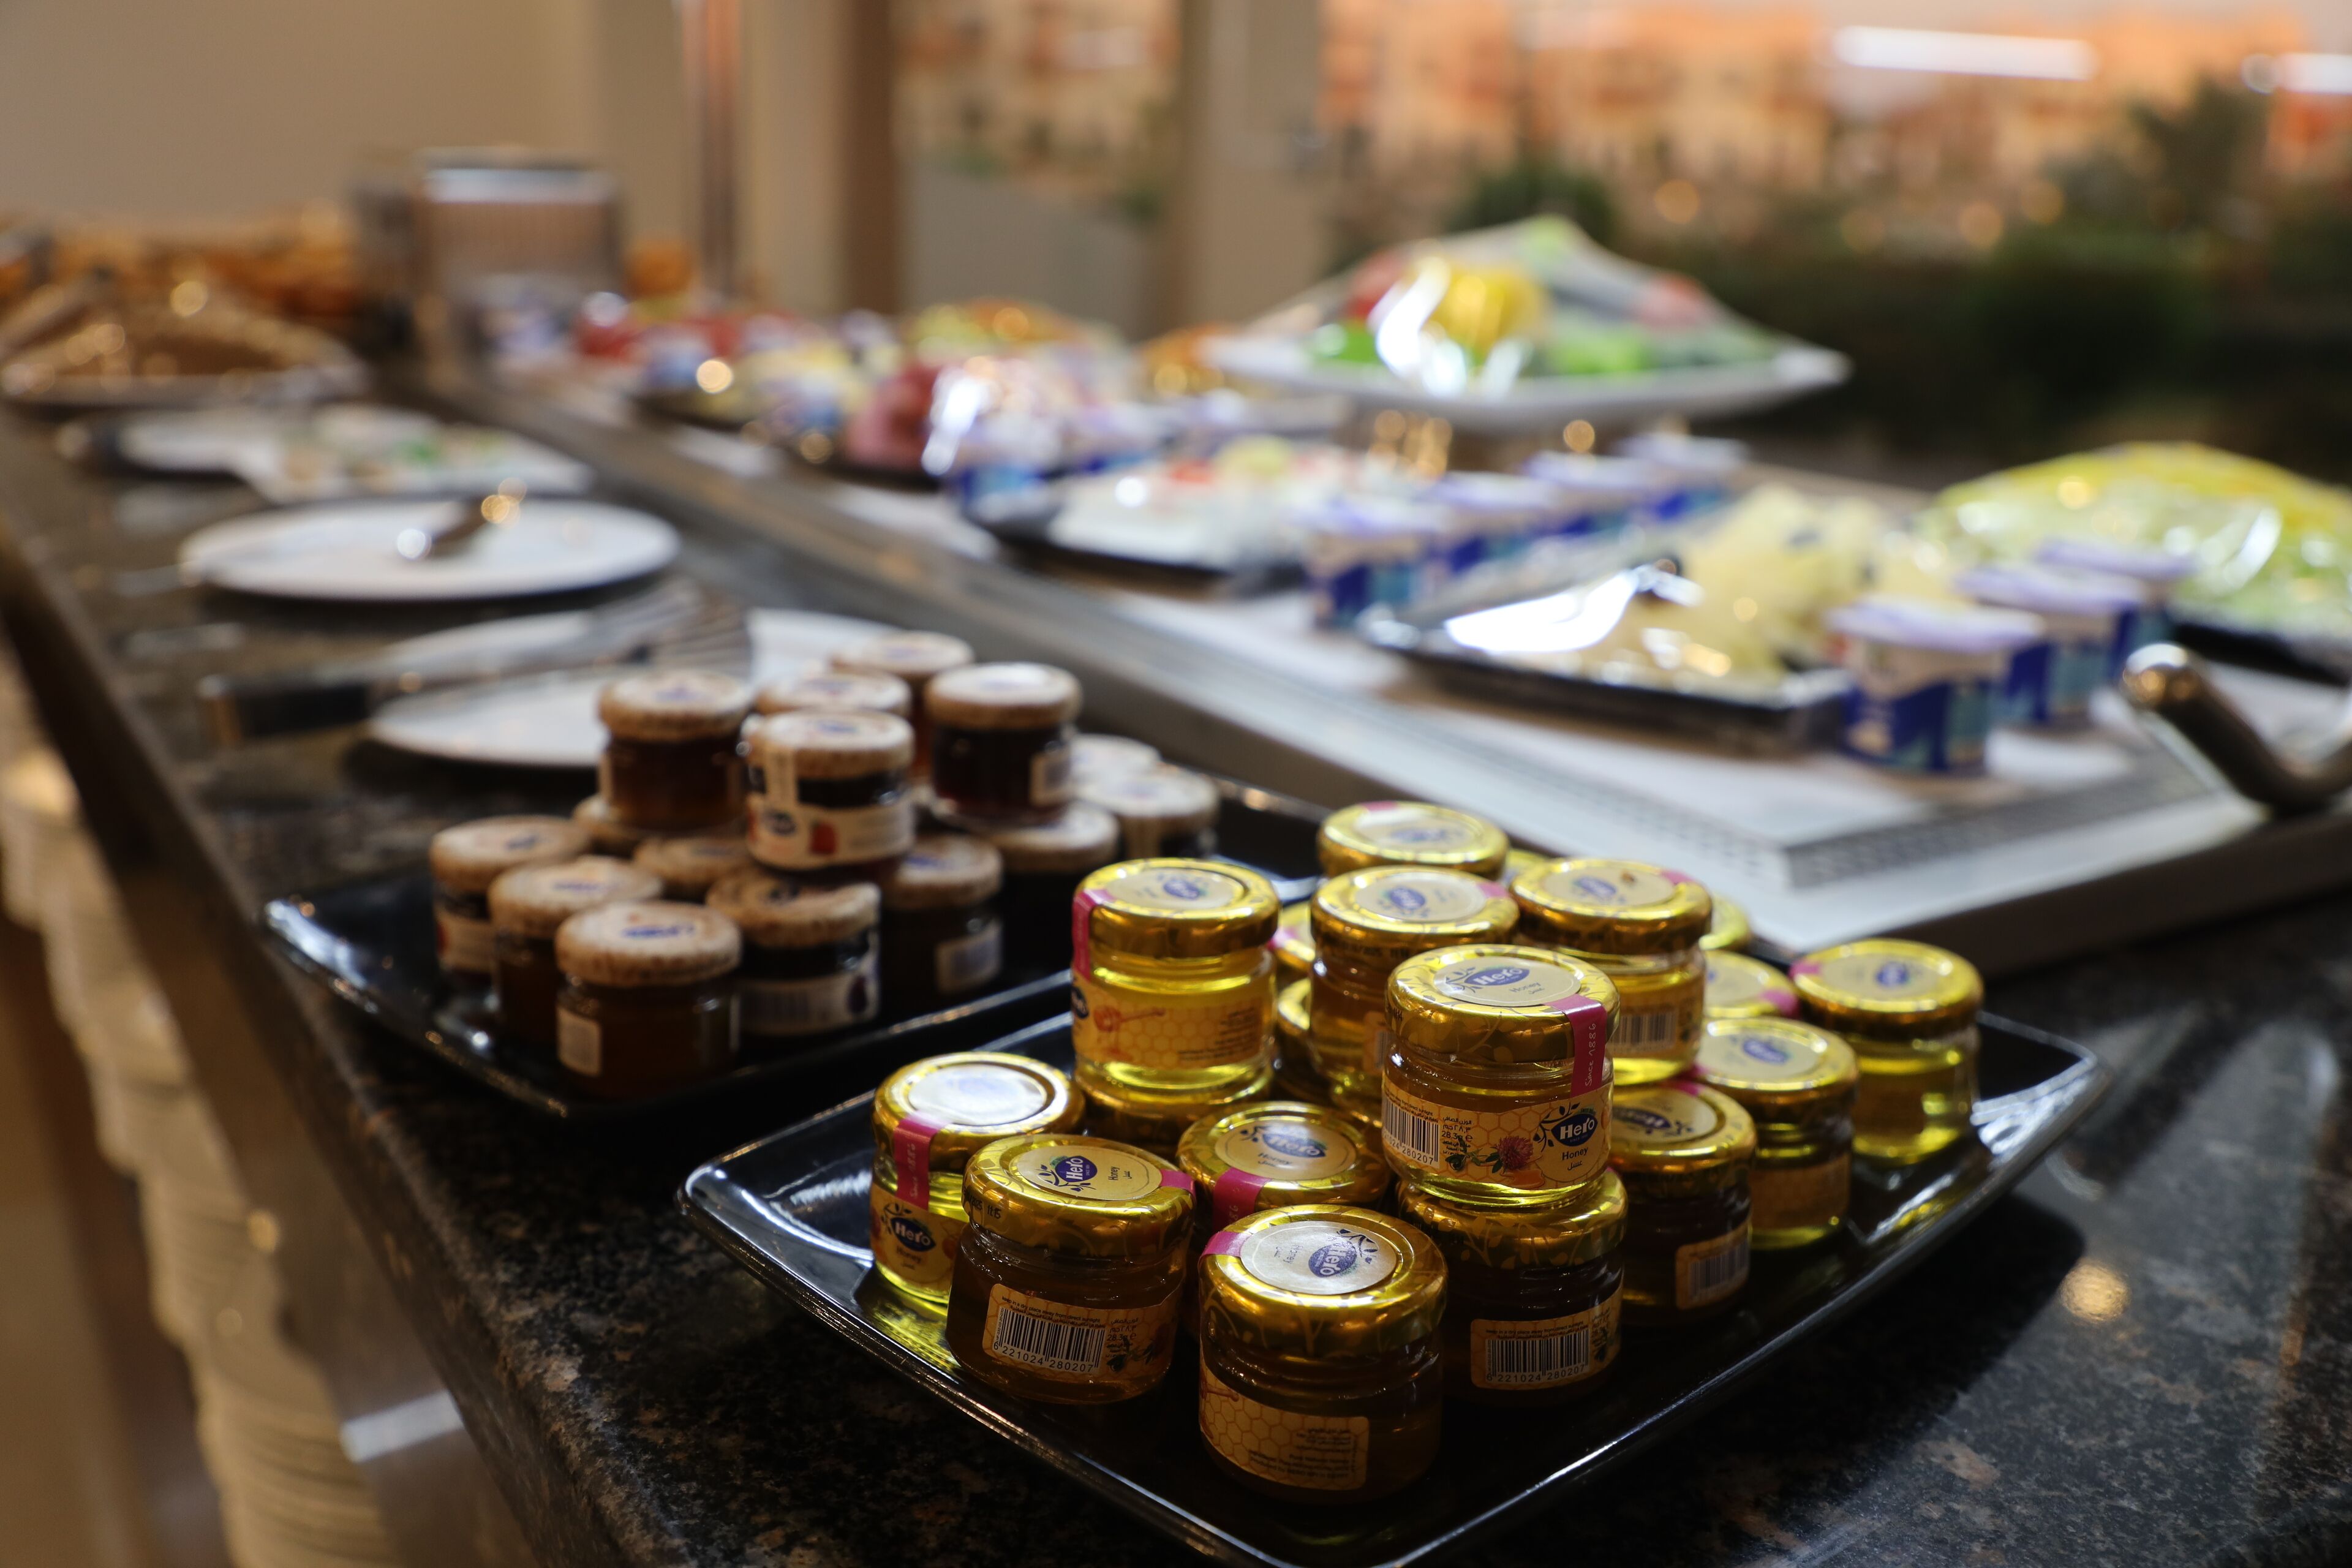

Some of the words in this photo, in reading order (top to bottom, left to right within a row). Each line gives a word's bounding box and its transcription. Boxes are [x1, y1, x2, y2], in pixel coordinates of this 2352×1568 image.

[1472, 967, 1524, 986] Hero
[1509, 982, 1542, 993] Honey
[1585, 1060, 1594, 1087] Since
[1559, 1117, 1595, 1140] Hero
[1402, 1145, 1434, 1165] 280207
[1562, 1147, 1588, 1161] Honey
[1066, 1157, 1084, 1181] Hero
[1107, 1166, 1120, 1181] Honey
[1568, 1160, 1583, 1170] عسل
[895, 1221, 931, 1246] Hero
[1283, 1244, 1304, 1264] Honey
[1319, 1242, 1348, 1276] Hero
[1002, 1346, 1043, 1365] 221024
[1049, 1359, 1093, 1373] 280207
[1498, 1373, 1542, 1382] 221024
[1547, 1364, 1585, 1381] 280207
